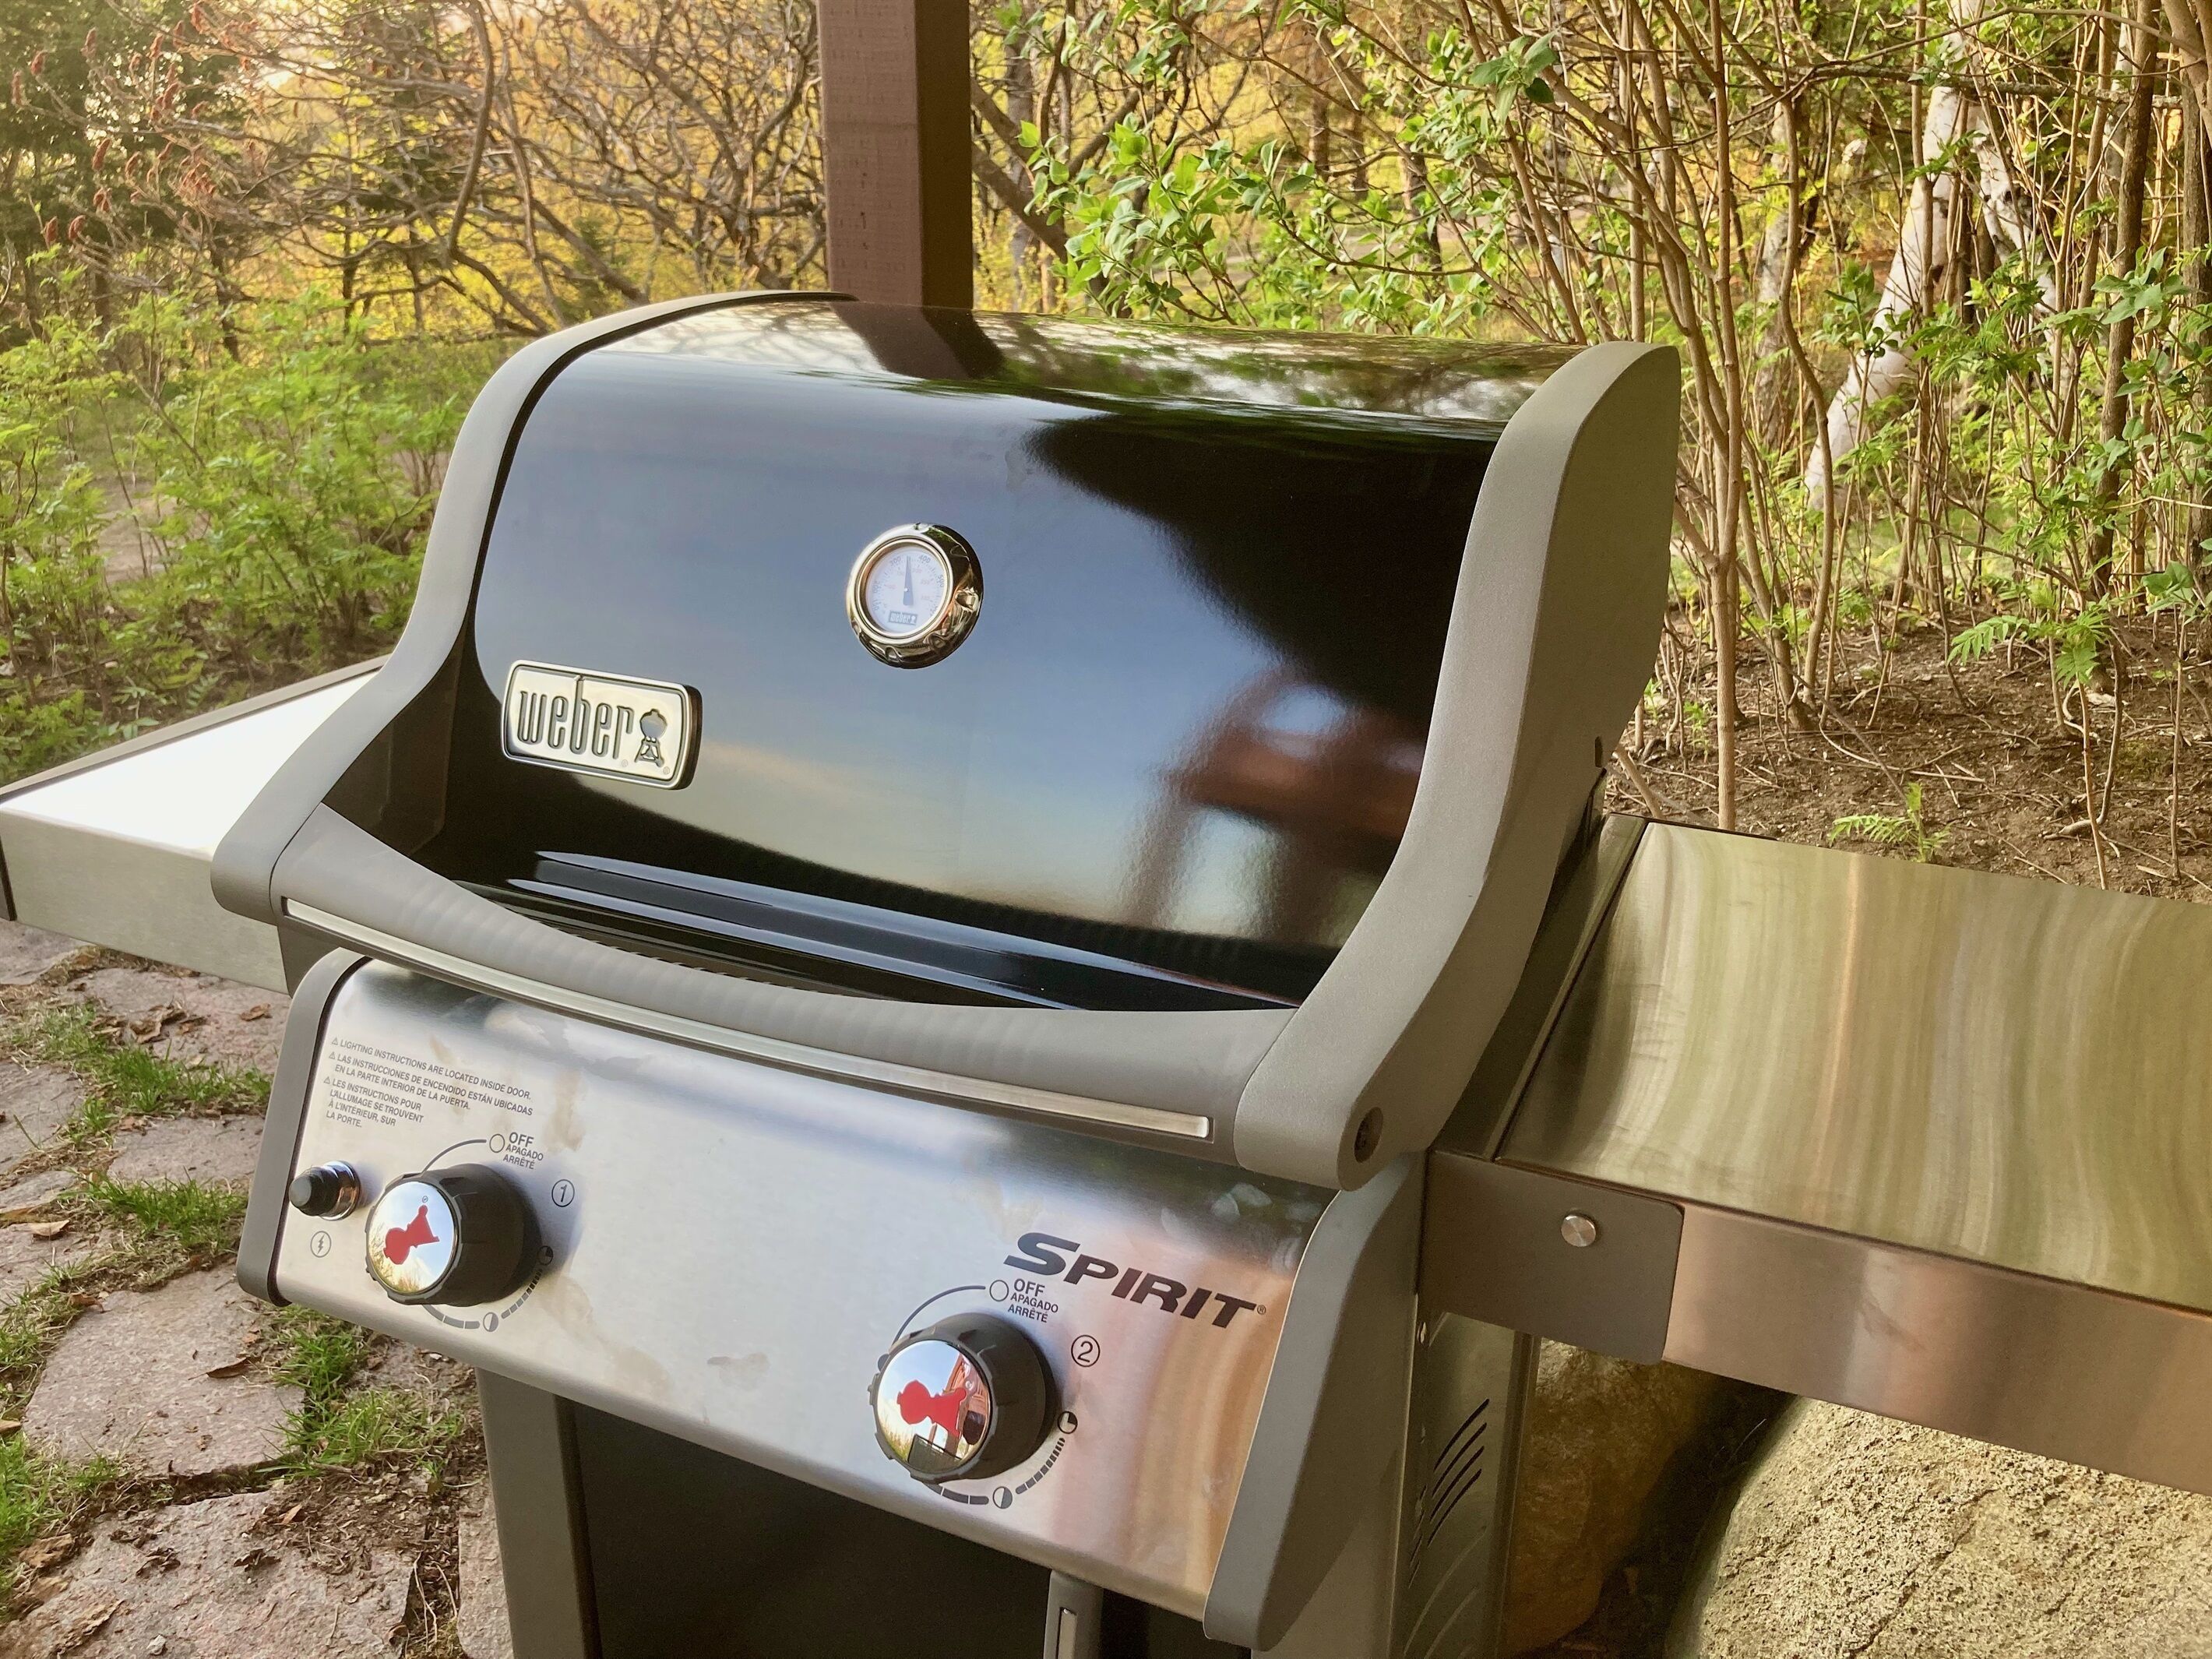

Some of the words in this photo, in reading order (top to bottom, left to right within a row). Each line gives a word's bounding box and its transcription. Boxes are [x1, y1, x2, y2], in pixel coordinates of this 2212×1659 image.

[918, 555, 931, 564] 400
[889, 611, 911, 624] weber
[516, 673, 635, 759] weber
[340, 1039, 373, 1055] LIGHTING
[374, 1048, 427, 1070] INSTRUCTIONS
[428, 1064, 444, 1075] ARE
[445, 1069, 480, 1085] LOCATED
[480, 1078, 506, 1093] INSIDE
[506, 1086, 531, 1100] DOOR.
[333, 1078, 347, 1089] LES
[347, 1083, 400, 1104] INSTRUCTIONS
[400, 1098, 421, 1111] POUR
[335, 1064, 346, 1073] EN
[346, 1067, 355, 1077] LA
[357, 1070, 381, 1084] PARTE
[381, 1077, 416, 1094] INTERIOR
[416, 1087, 428, 1097] DE
[428, 1090, 438, 1101] LA
[439, 1094, 470, 1110] PUERTA.
[337, 1053, 351, 1064] LAS
[352, 1058, 410, 1081] INSTRUCCIONES
[411, 1074, 422, 1084] DE
[423, 1078, 467, 1097] ENCENDIDO
[467, 1090, 493, 1104] ESTÁN
[494, 1098, 534, 1116] UBICADAS
[330, 1089, 373, 1108] L'ALLUMAGE
[374, 1101, 384, 1111] SE
[384, 1105, 424, 1123] TROUVENT
[335, 1102, 379, 1122] L'INTÉRIEUR,
[380, 1115, 396, 1126] SUR
[326, 1110, 335, 1119] LA
[336, 1113, 362, 1128] PORTE.
[509, 1132, 534, 1147] OFF
[503, 1153, 535, 1170] ARRÊTÉ
[505, 1143, 544, 1161] APAGADO
[560, 1185, 568, 1203] 1
[1013, 1278, 1045, 1297] OFF
[1007, 1303, 1048, 1323] ARRÊTÉ
[1010, 1293, 1059, 1314] APAGADO
[1077, 1340, 1094, 1363] 2
